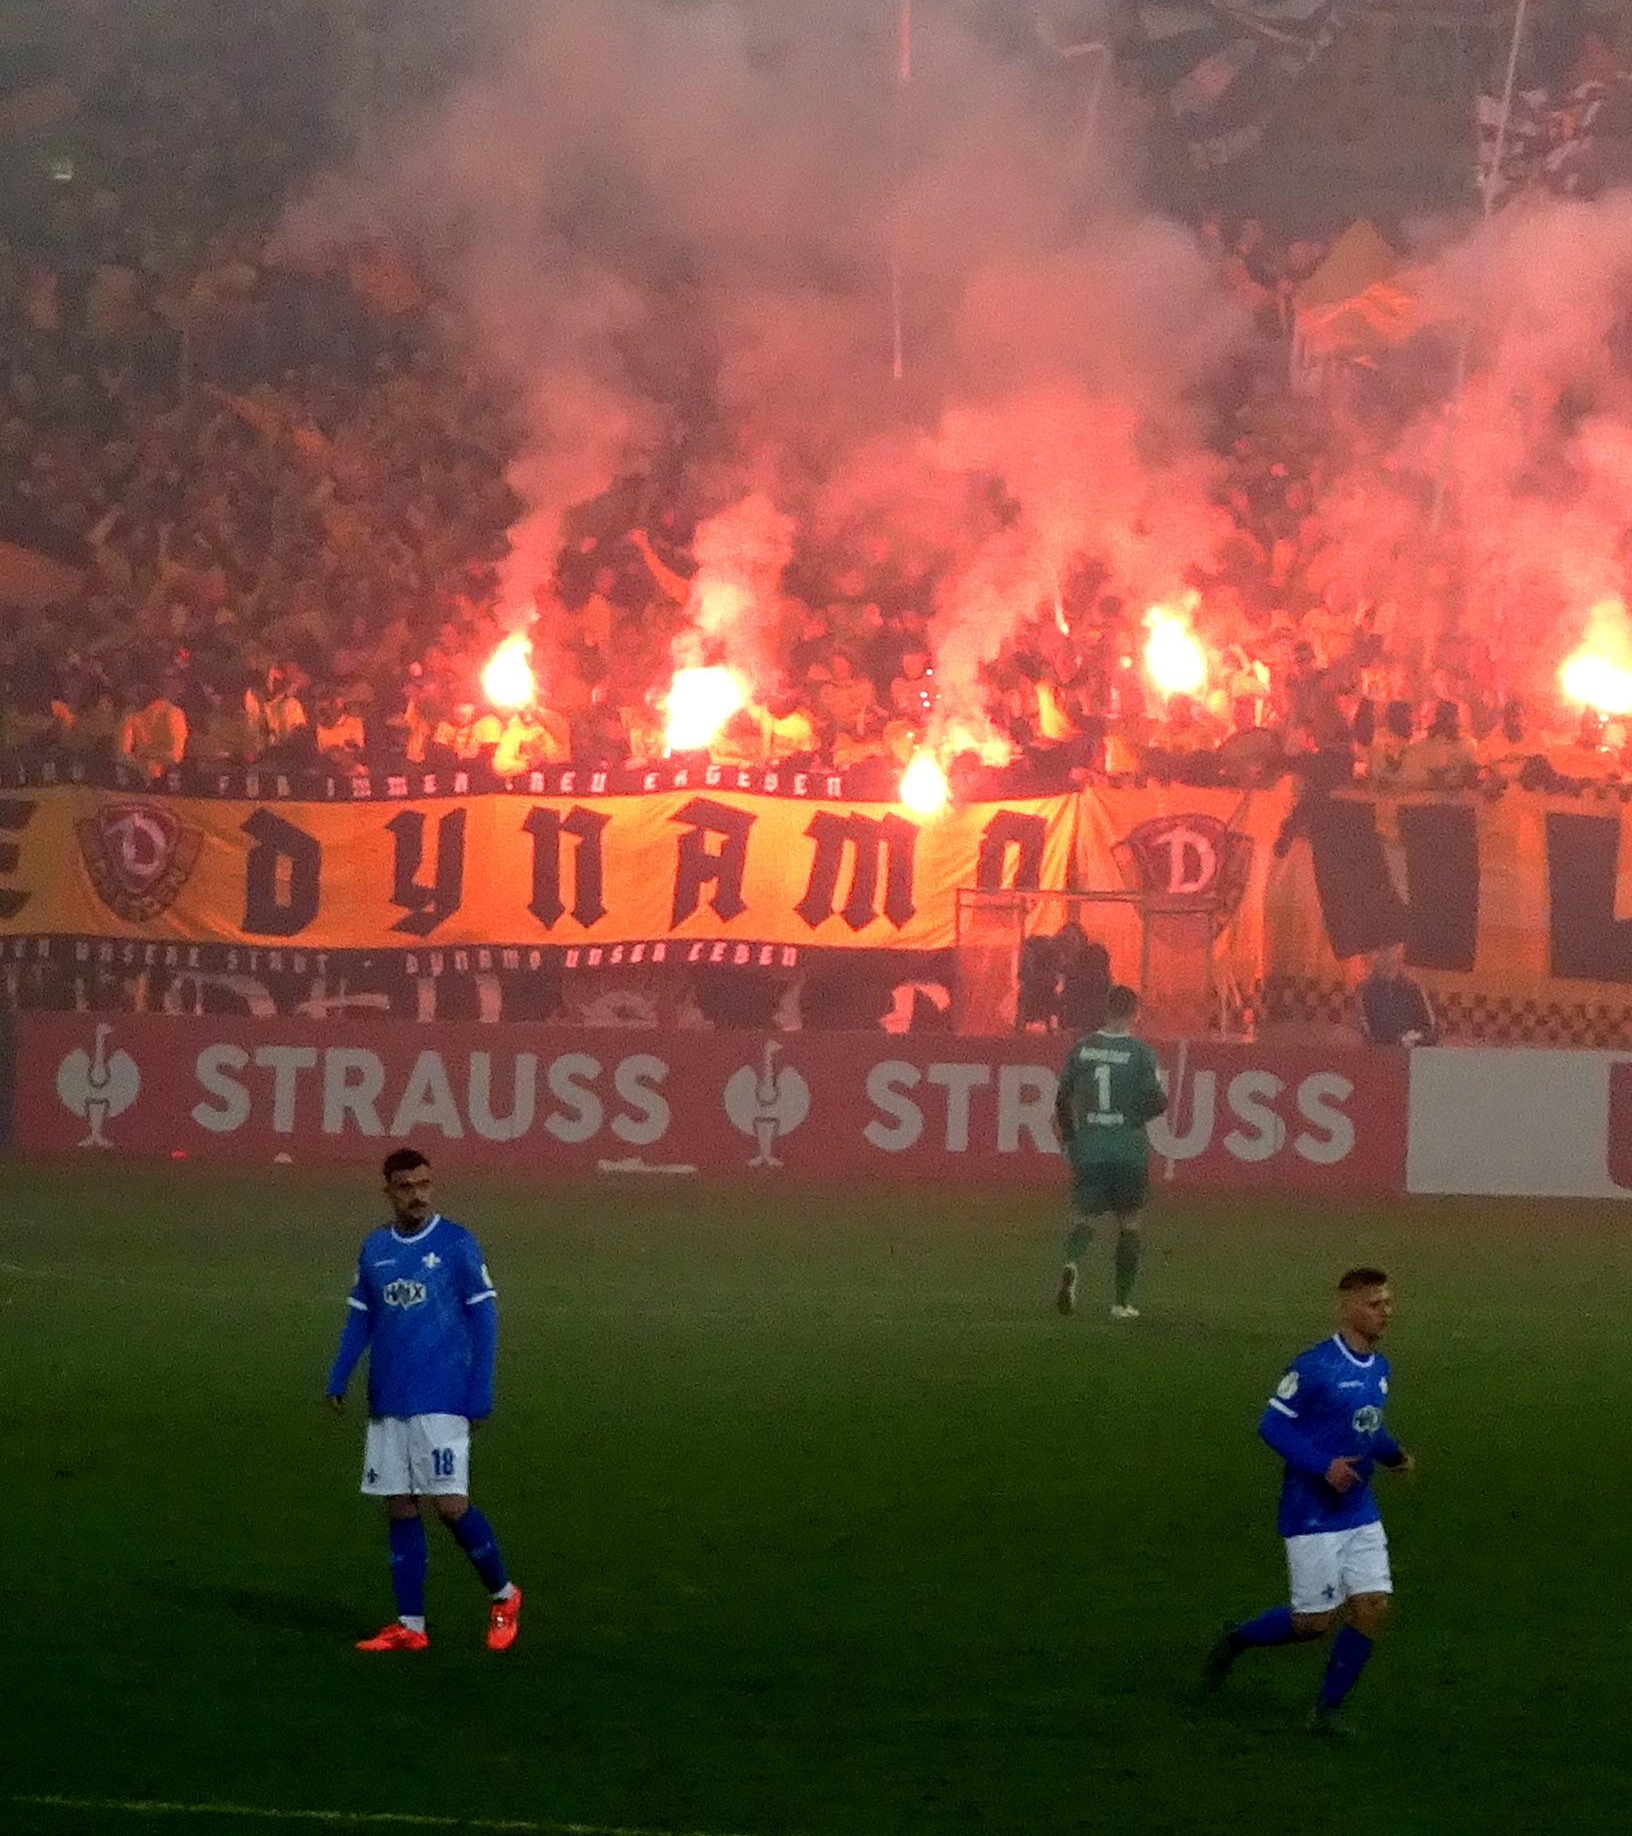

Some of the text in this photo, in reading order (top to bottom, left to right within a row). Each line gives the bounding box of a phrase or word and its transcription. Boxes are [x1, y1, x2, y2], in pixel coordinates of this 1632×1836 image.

[504, 769, 607, 794] REU
[192, 1043, 671, 1145] STRAUSS
[863, 1059, 1357, 1165] STRUSS
[1094, 1064, 1112, 1111] 1
